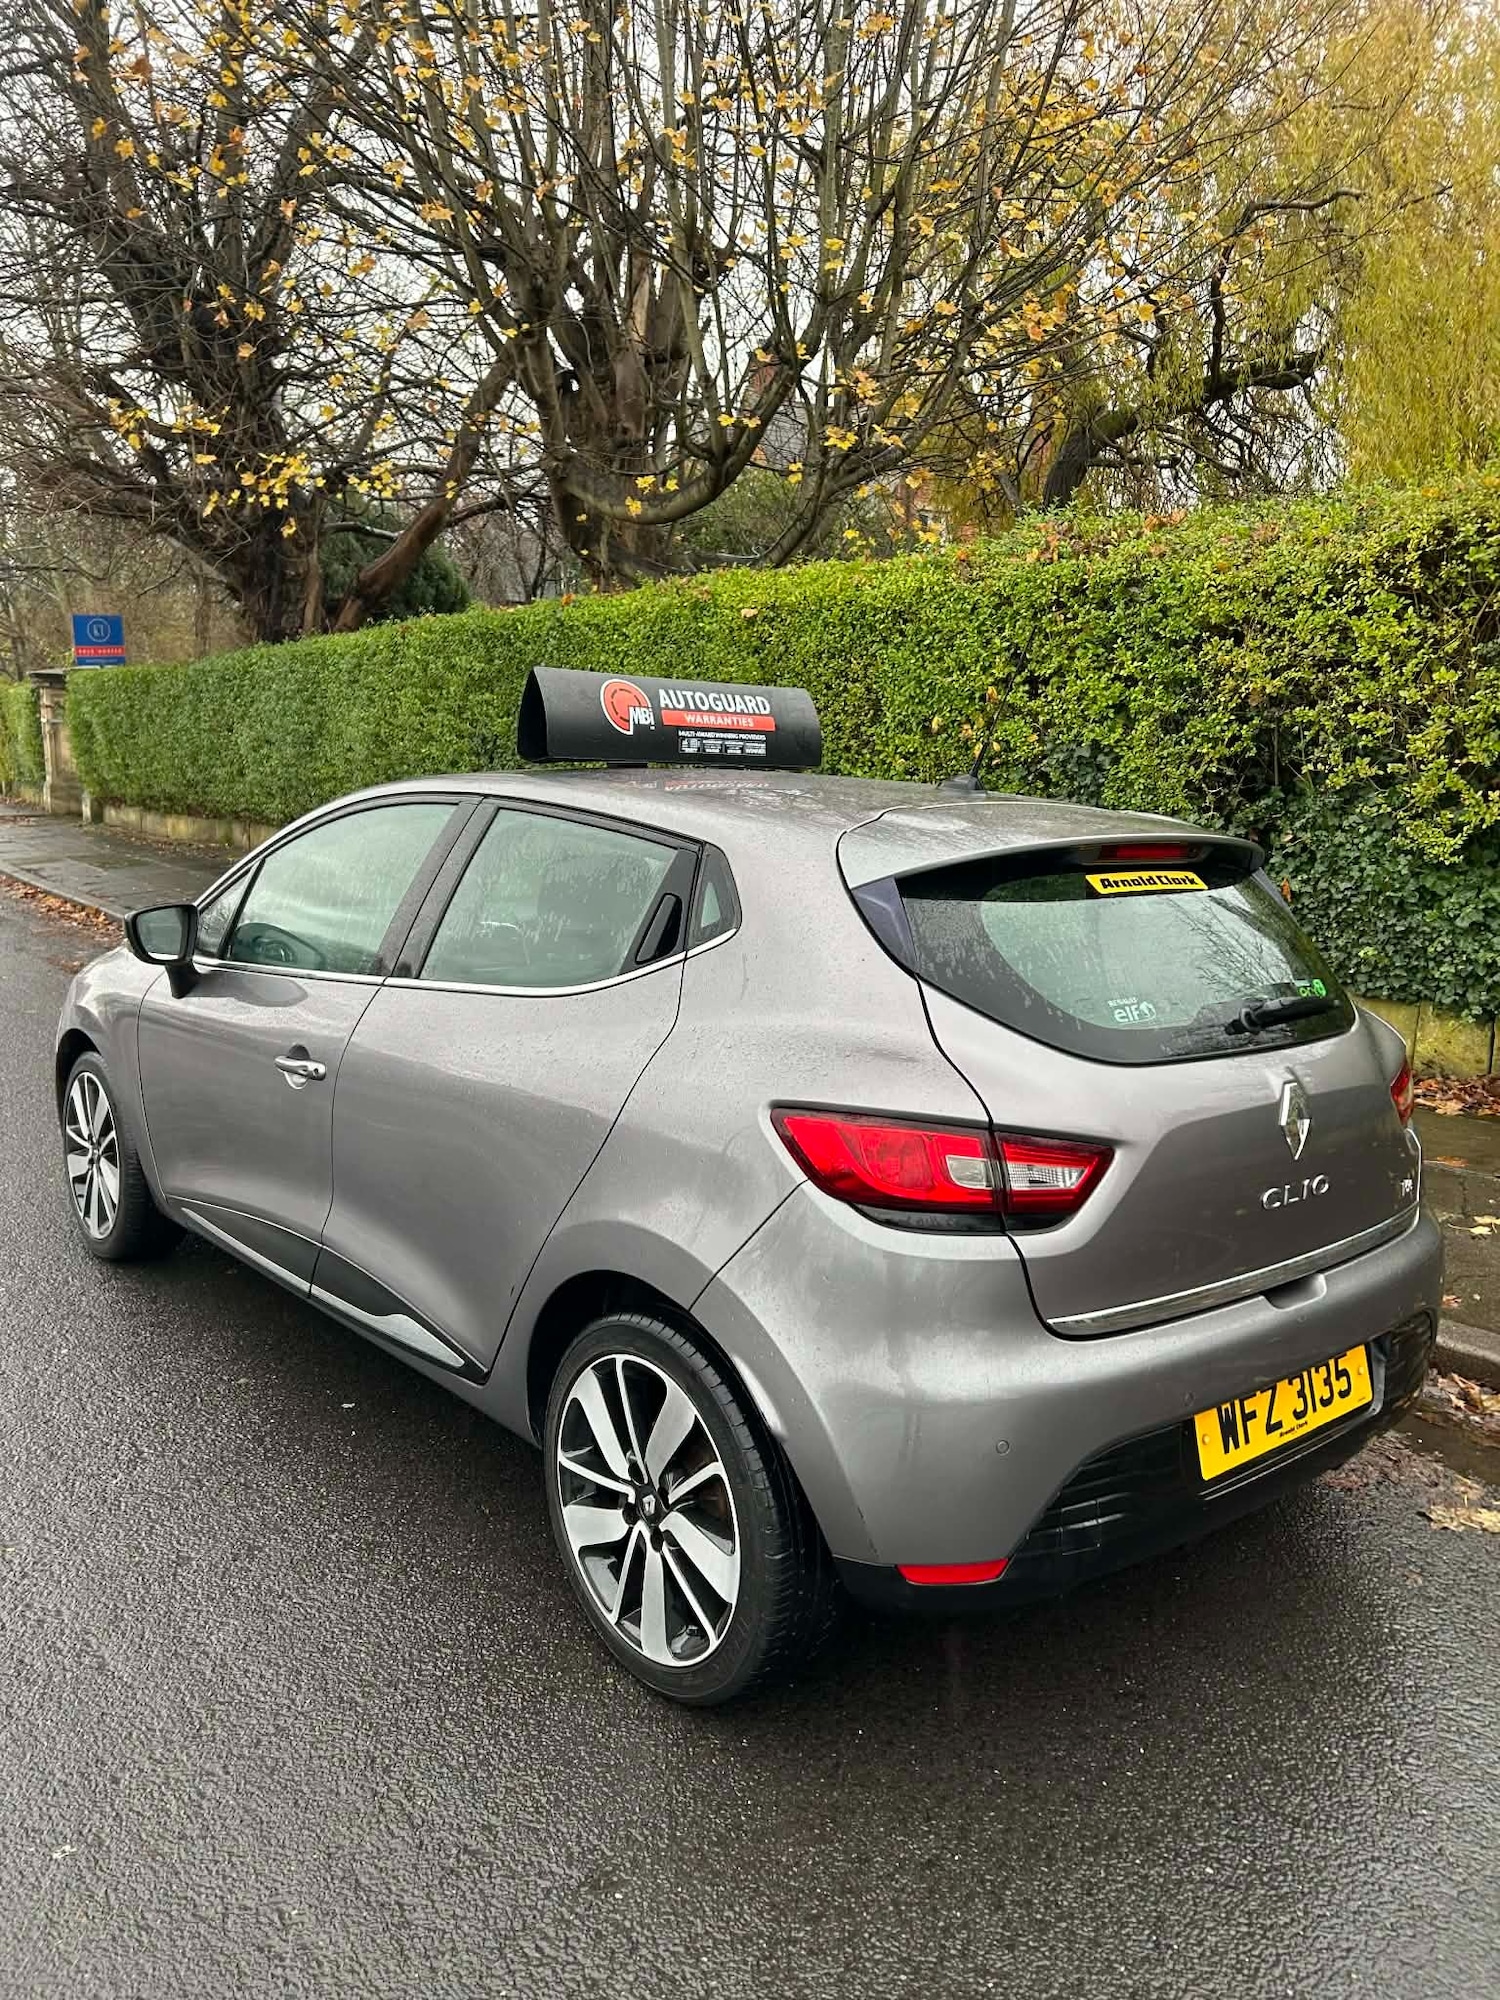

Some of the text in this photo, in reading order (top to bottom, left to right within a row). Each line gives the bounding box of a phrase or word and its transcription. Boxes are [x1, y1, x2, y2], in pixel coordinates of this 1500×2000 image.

[658, 688, 771, 715] AUTOGUARD
[684, 712, 754, 728] WARRANTIES
[1099, 874, 1199, 890] Arnold Clark
[1260, 1174, 1330, 1210] CLIO
[1216, 1352, 1352, 1455] WFZ 3135
